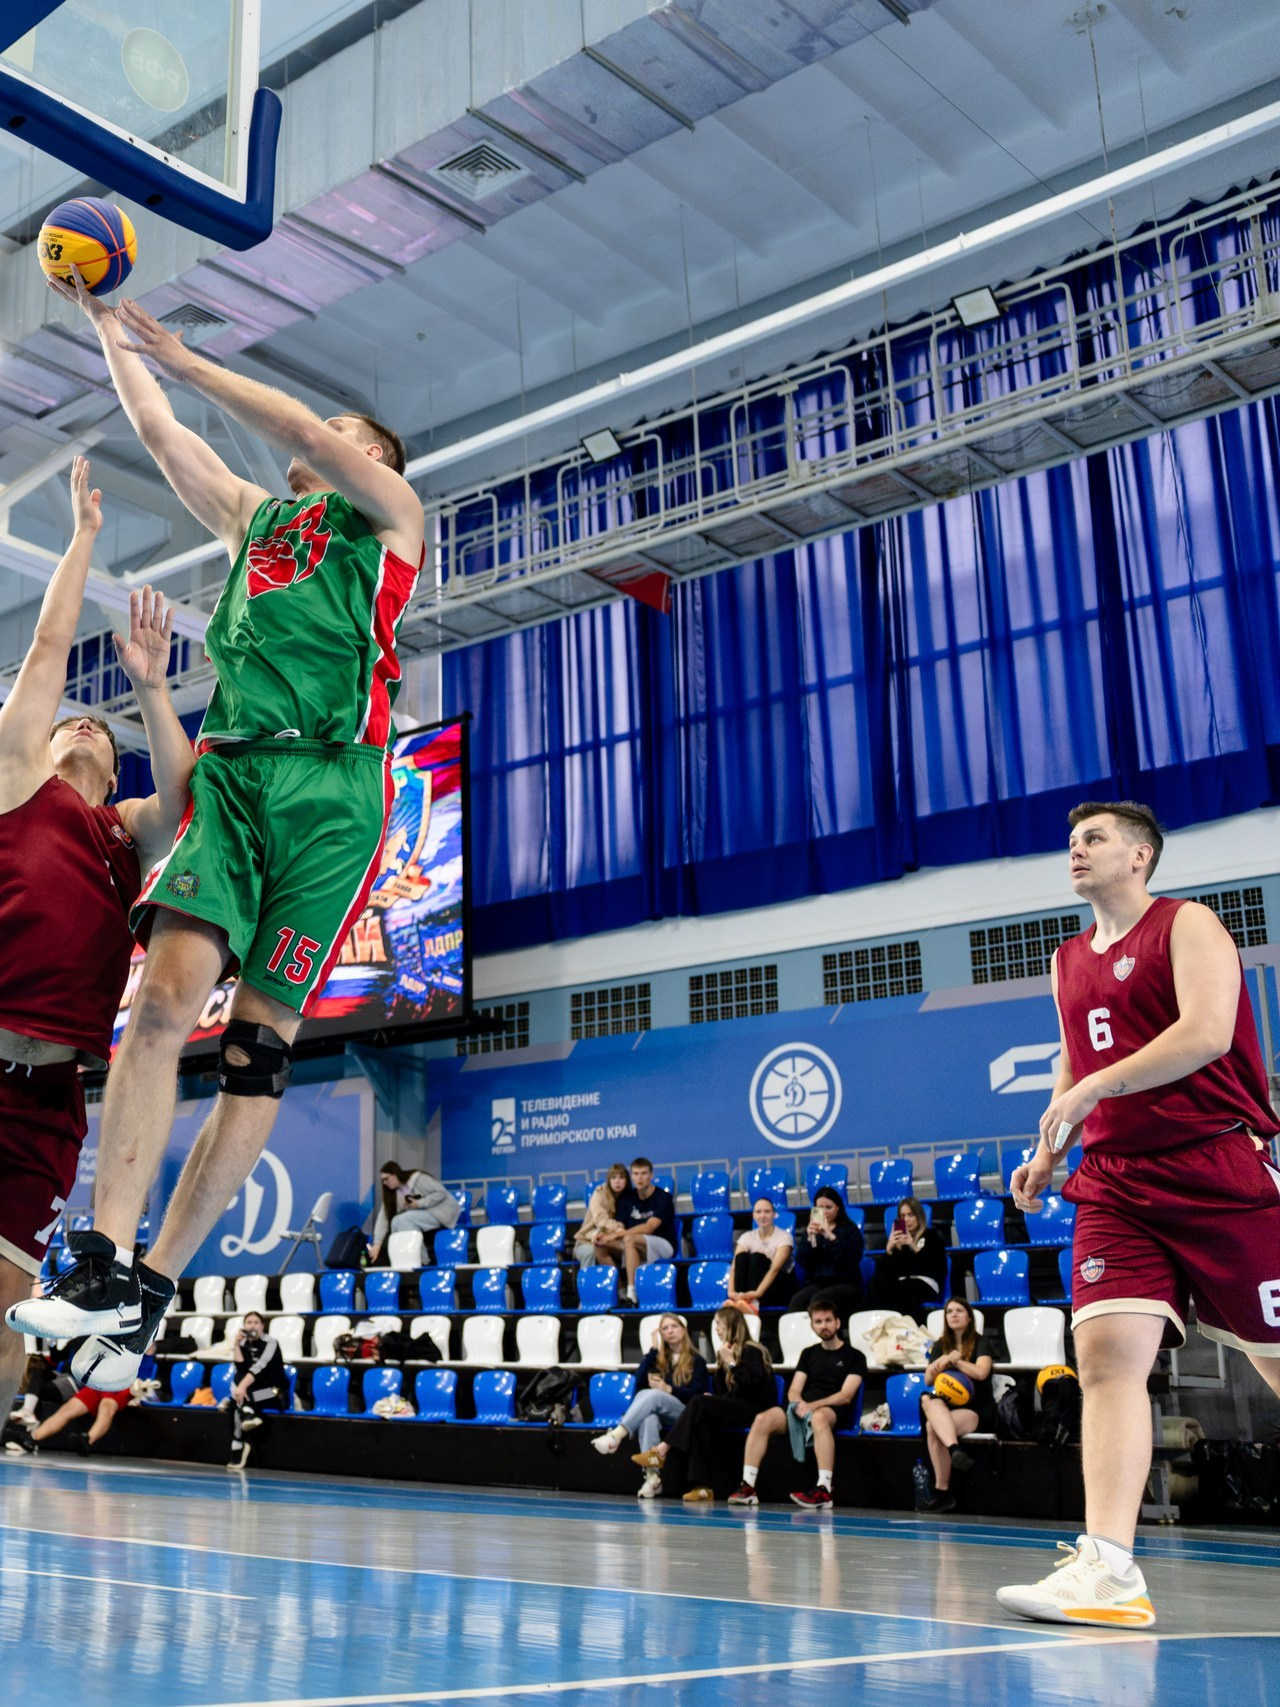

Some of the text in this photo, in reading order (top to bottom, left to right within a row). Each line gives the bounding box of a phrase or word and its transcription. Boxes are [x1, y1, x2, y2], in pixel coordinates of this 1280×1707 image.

[266, 925, 322, 985] 15
[423, 929, 463, 957] ЛДПР
[1087, 1007, 1114, 1052] 6
[521, 1092, 601, 1113] ТЕЛЕВИДЕНИЕ
[521, 1113, 569, 1130] И РАДИО
[521, 1124, 637, 1148] ПРИМОРСКОГО КРАЯ
